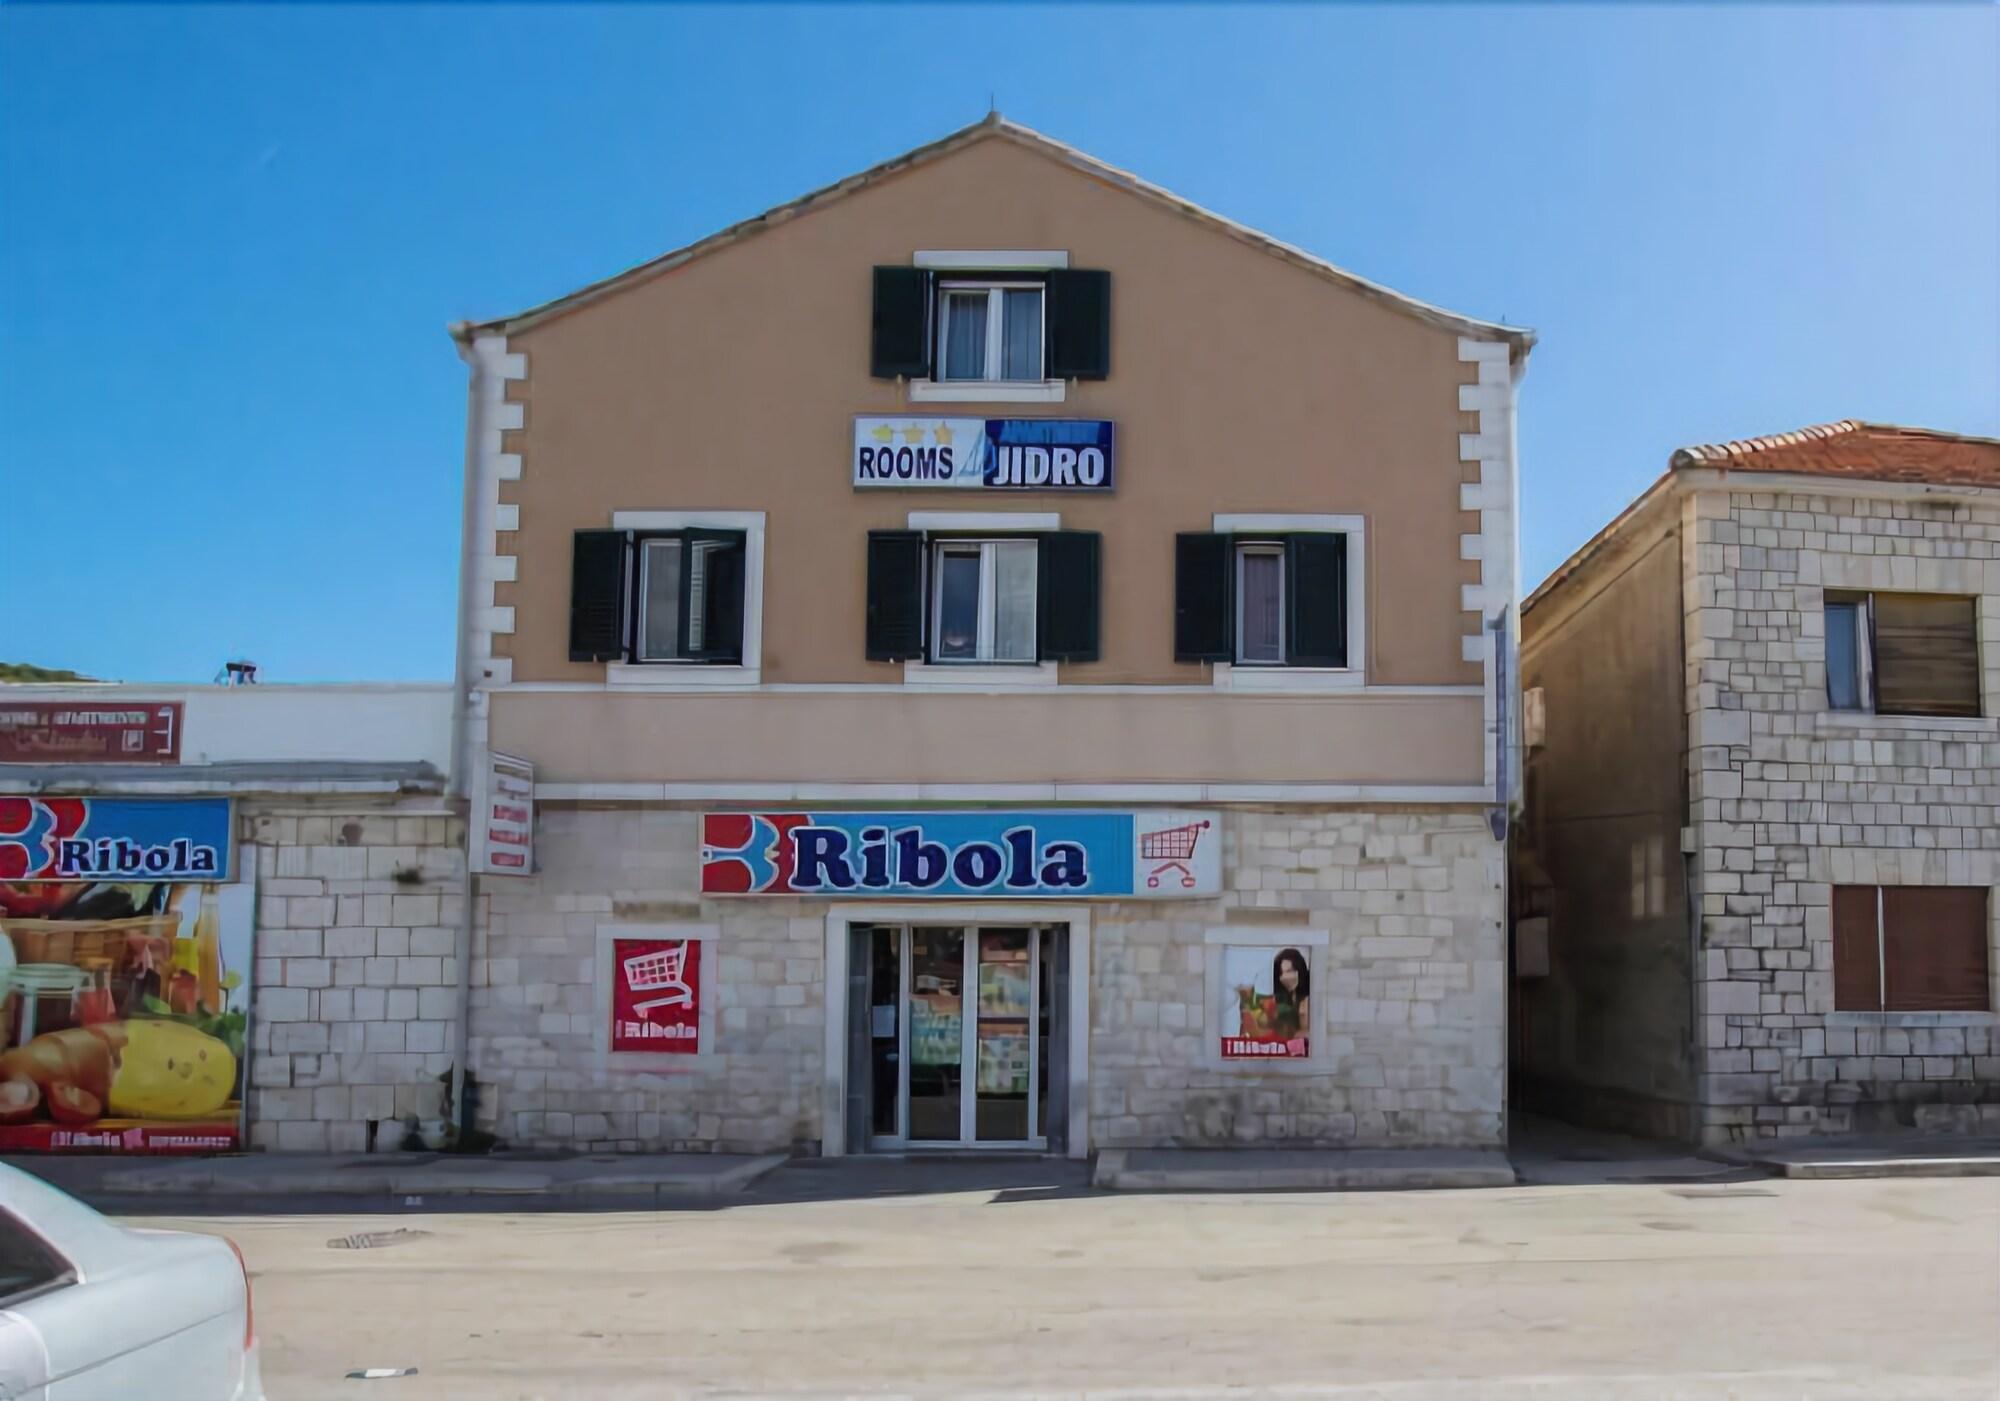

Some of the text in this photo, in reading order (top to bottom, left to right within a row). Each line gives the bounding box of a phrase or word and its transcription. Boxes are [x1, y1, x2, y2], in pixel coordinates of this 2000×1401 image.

[858, 445, 1106, 486] ROOMS JIDRO
[58, 837, 215, 874] Ribola
[789, 826, 1090, 889] Ribola
